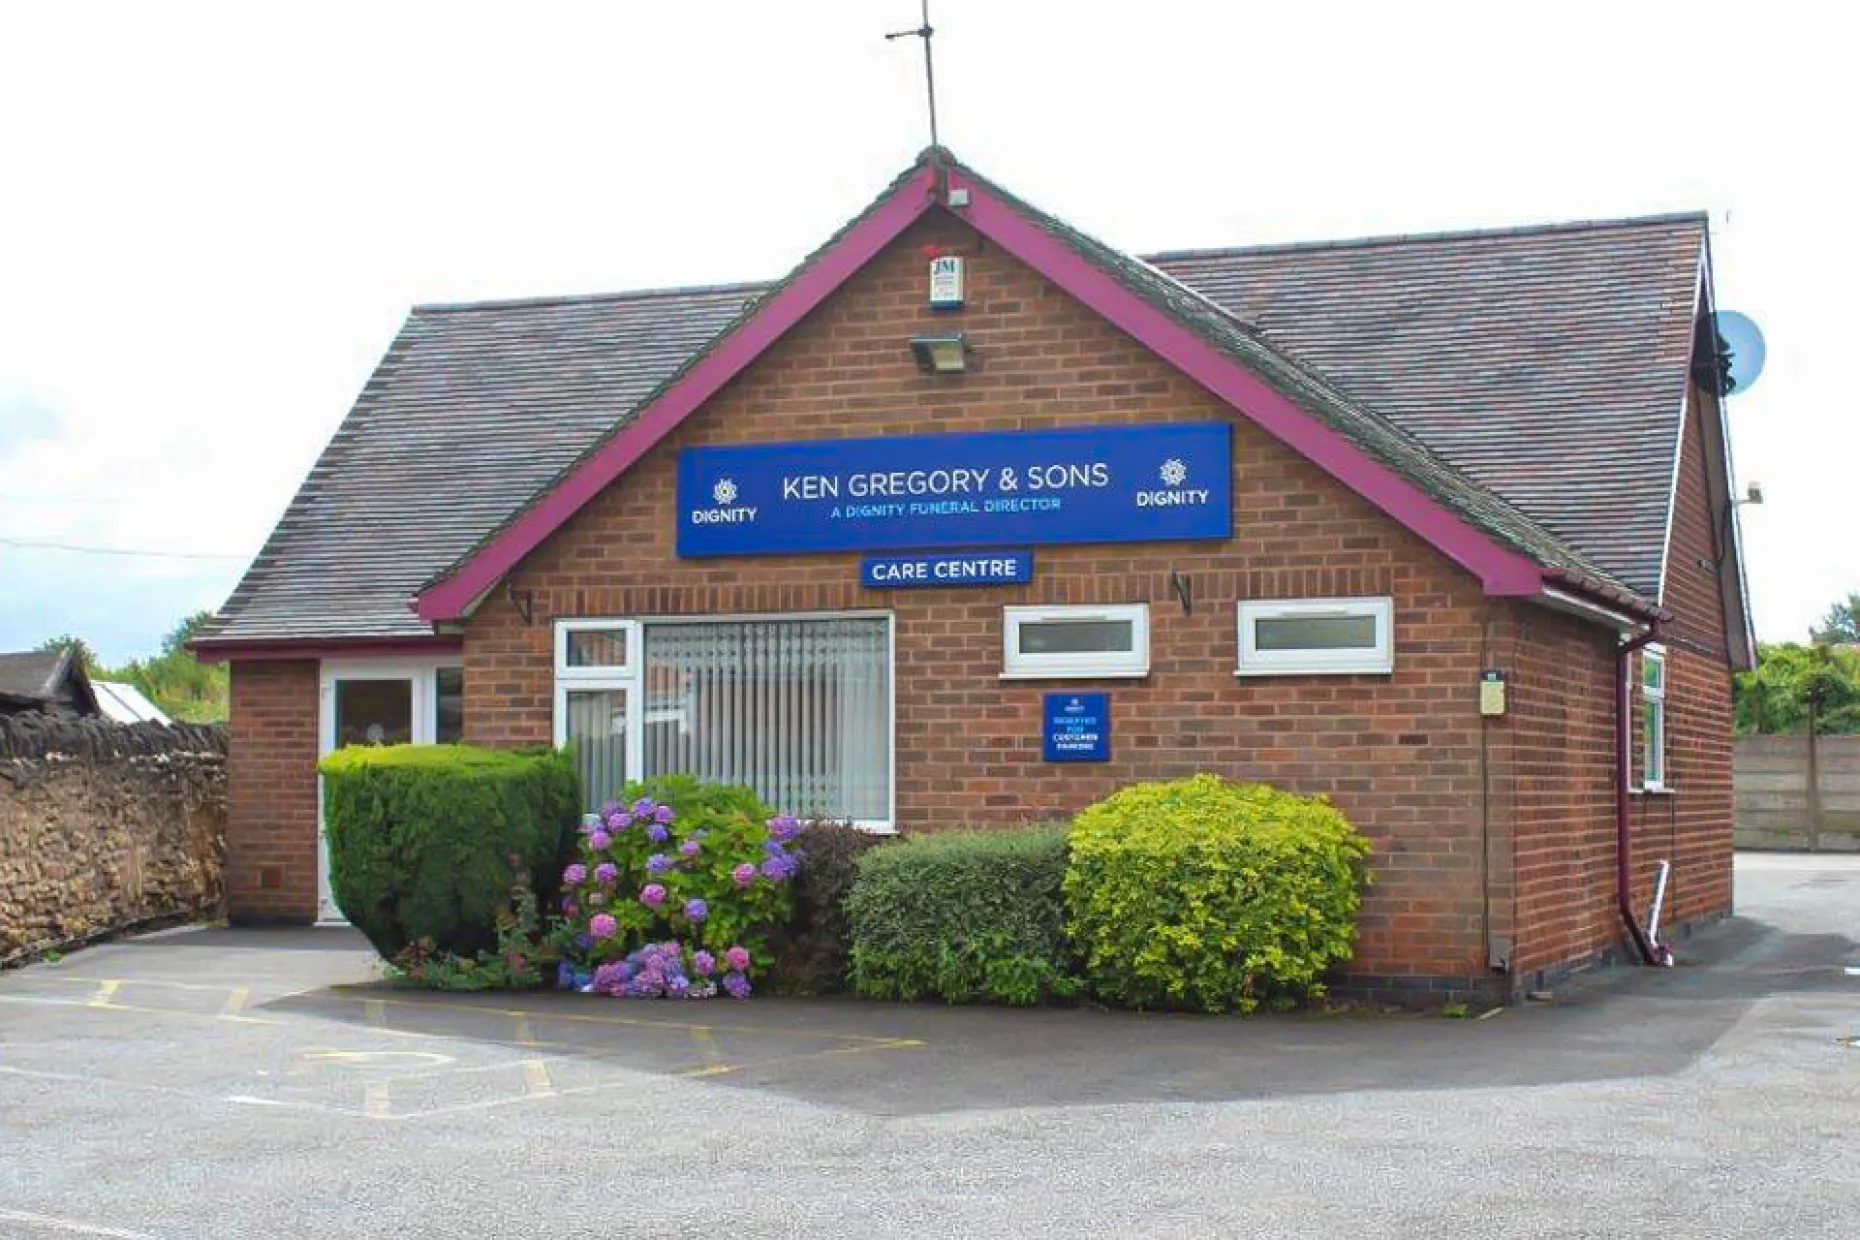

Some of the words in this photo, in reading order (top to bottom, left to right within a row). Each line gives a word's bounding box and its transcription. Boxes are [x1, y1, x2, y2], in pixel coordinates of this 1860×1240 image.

[783, 475, 838, 500] KEN
[848, 468, 991, 497] GREGORY
[998, 466, 1018, 491] &
[1028, 462, 1110, 490] SONS
[831, 506, 842, 519] A
[846, 504, 905, 518] DIGNITY
[909, 501, 980, 515] FUNERAL
[983, 498, 1061, 513] DIRECTOR
[1136, 490, 1209, 507] DIGNITY
[691, 507, 757, 524] DIGNITY
[871, 561, 929, 581] CARE
[933, 558, 1017, 578] CENTRE
